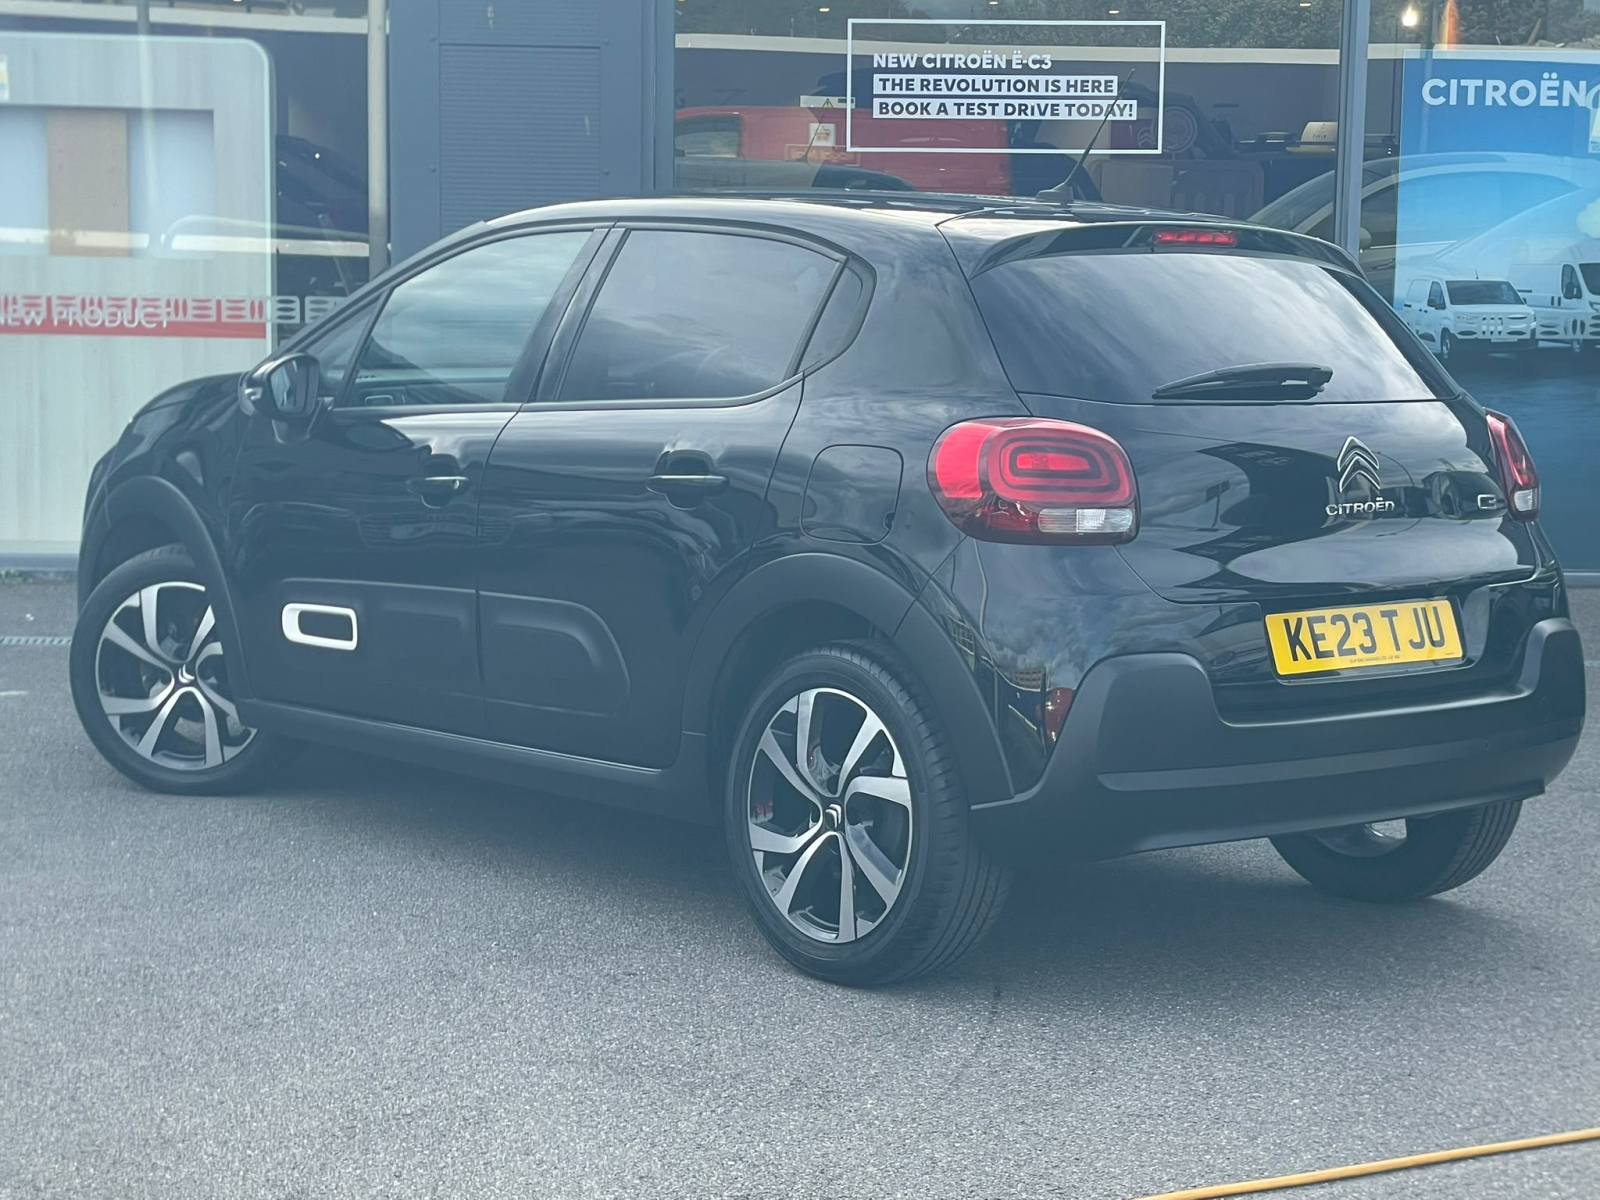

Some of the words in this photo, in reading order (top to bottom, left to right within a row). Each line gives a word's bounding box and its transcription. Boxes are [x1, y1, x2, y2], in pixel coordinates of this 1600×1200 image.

[873, 52, 918, 68] NEW
[922, 50, 1007, 69] CITROËN
[1011, 50, 1052, 69] Ë-C3
[879, 77, 915, 91] THE
[920, 78, 1040, 92] REVOLUTION
[1045, 79, 1061, 93] IS
[1066, 79, 1114, 93] HERE
[1421, 72, 1587, 107] CITROËN
[879, 102, 932, 115] BOOK
[936, 102, 949, 116] A
[953, 102, 999, 116] TEST
[1004, 103, 1060, 116] DRIVE
[1064, 103, 1133, 117] TODAY!
[53, 306, 172, 328] PRODUCT
[1283, 612, 1377, 662] KE23
[1380, 606, 1446, 652] TJU
